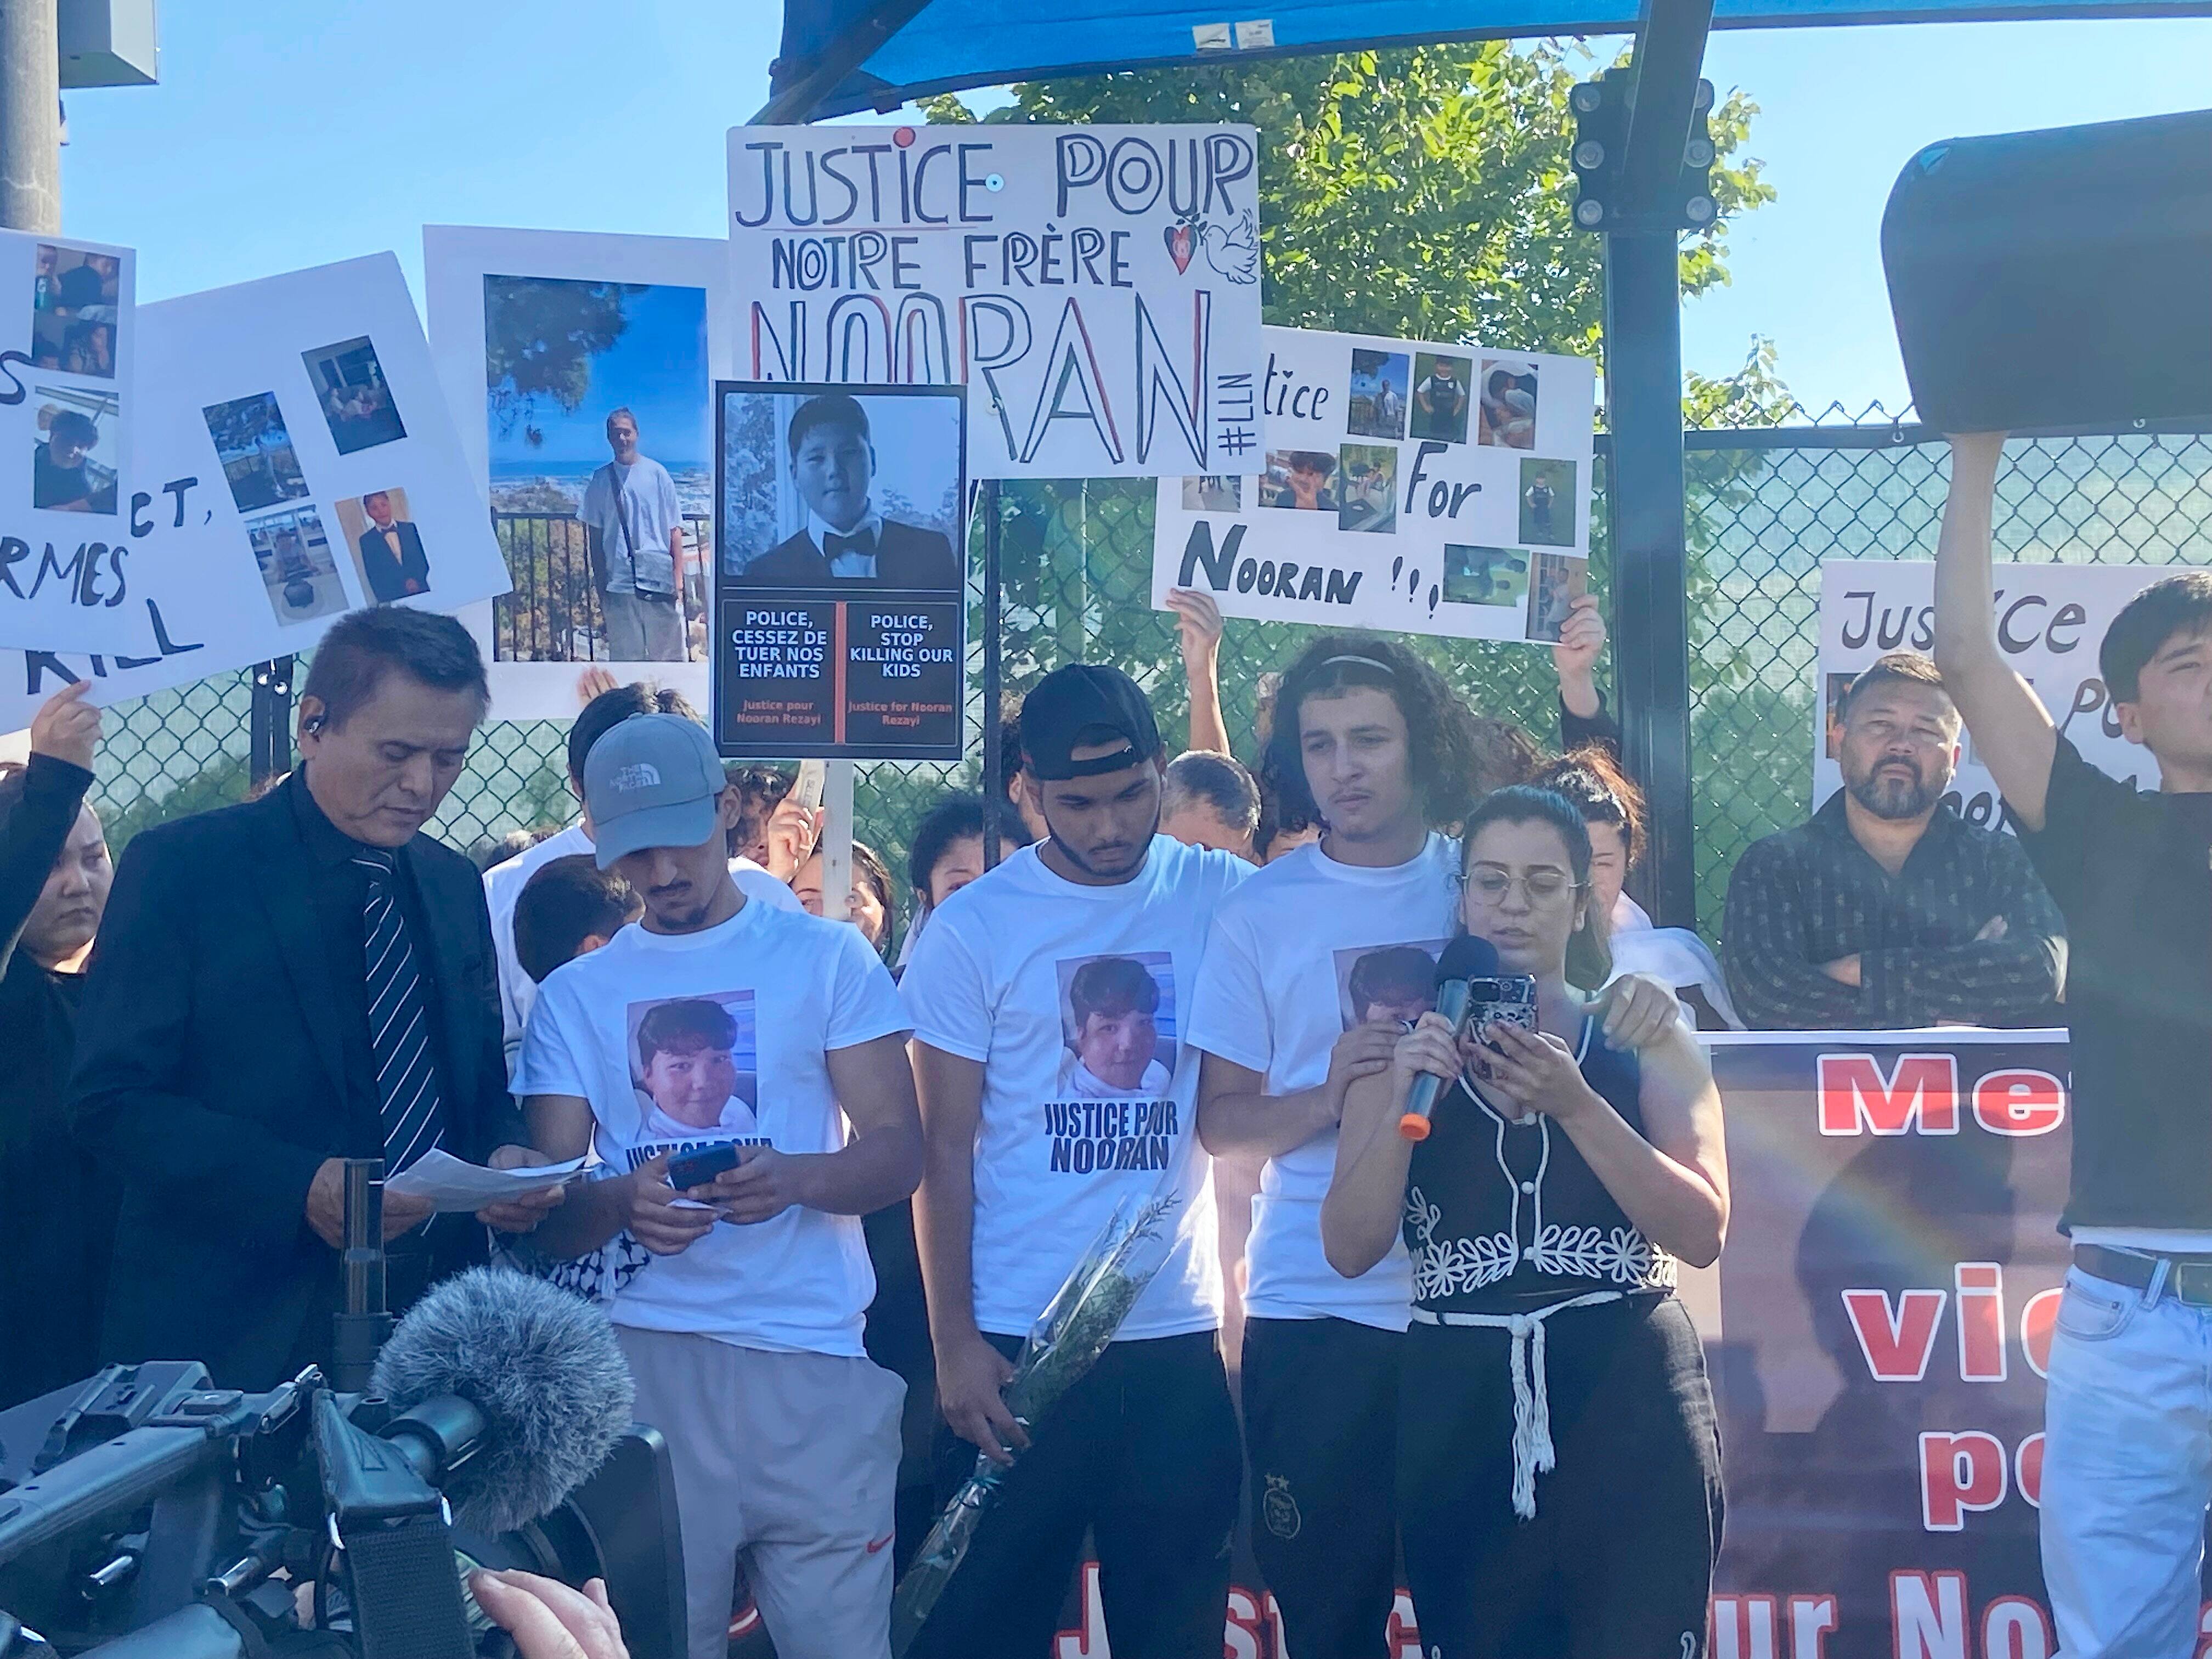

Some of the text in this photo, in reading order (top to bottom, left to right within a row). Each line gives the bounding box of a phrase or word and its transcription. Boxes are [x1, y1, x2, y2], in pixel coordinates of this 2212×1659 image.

[1054, 133, 1253, 218] POUR
[772, 224, 1133, 290] NOTRE FRÈRE
[1404, 441, 1482, 519] For
[746, 610, 814, 629] POLICE,
[871, 615, 933, 631] POLICE,
[732, 630, 827, 645] CESSEZ DE
[881, 633, 923, 646] STOP
[735, 647, 823, 662] TUER NOS
[850, 648, 953, 663] KILLING OUR
[739, 663, 820, 679] ENFANTS
[882, 664, 921, 678] KIDS
[743, 699, 814, 713] Justice pour
[848, 701, 952, 713] Justice for Nooran
[737, 713, 779, 724] Nooran
[1816, 1053, 2071, 1137] Me
[1045, 1103, 1129, 1138] JUSTICE
[1051, 1136, 1169, 1174] NOORAN
